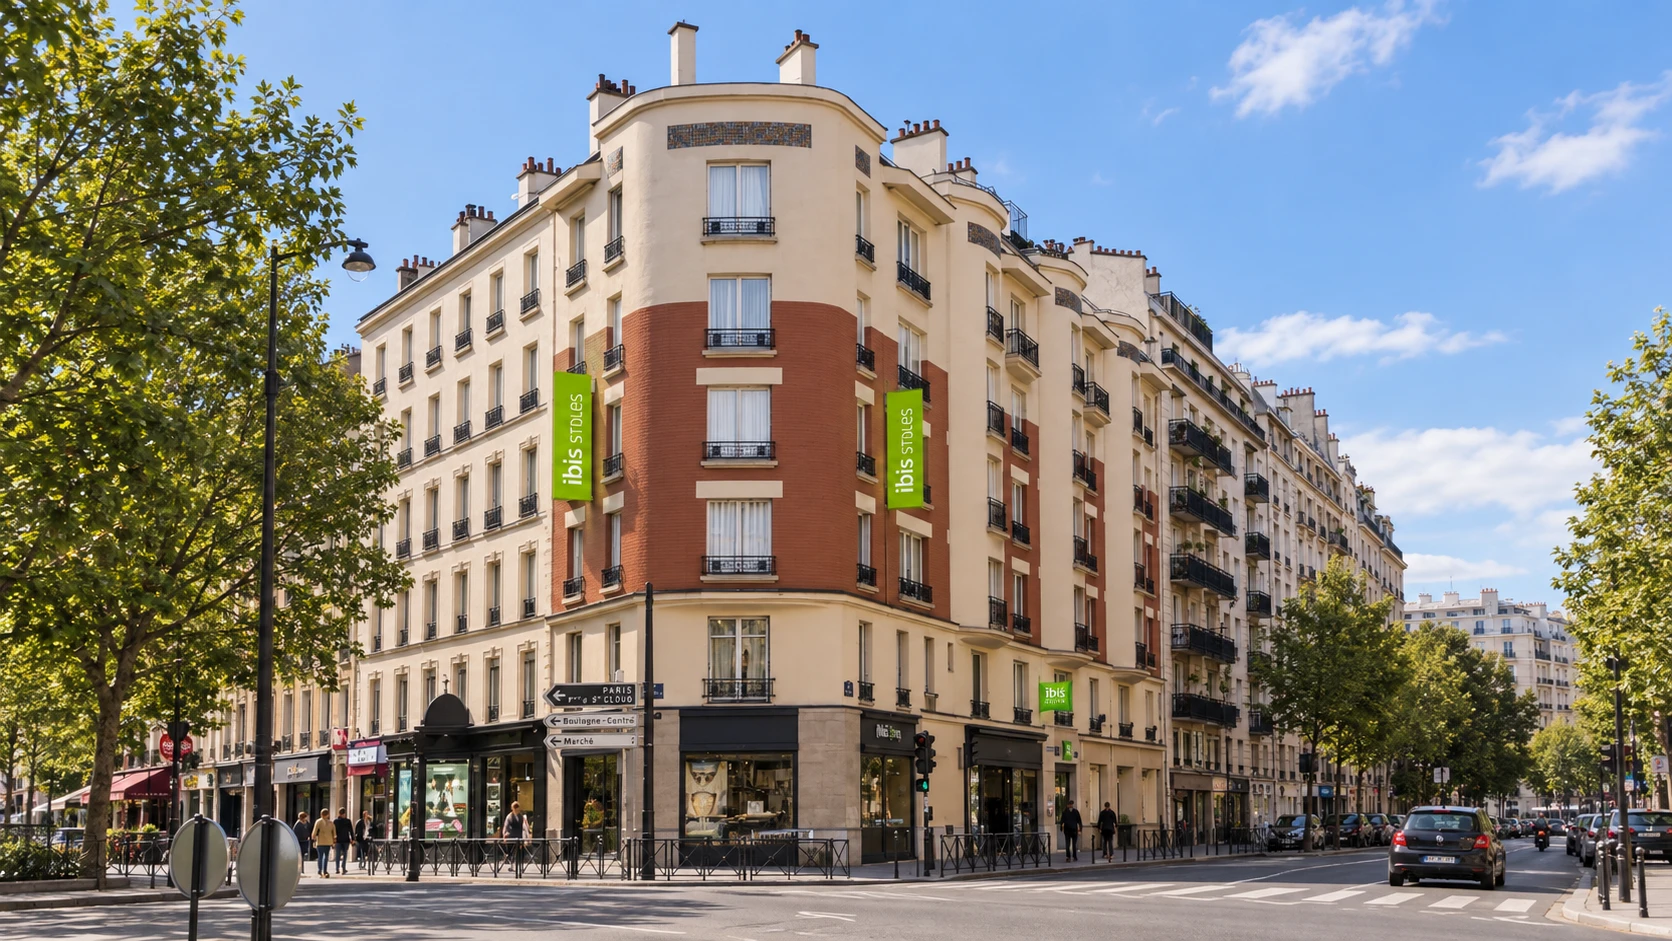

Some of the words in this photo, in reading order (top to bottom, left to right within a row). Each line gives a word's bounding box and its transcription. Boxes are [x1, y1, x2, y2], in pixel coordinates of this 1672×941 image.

[562, 448, 583, 485] ibis
[895, 458, 914, 493] ibis
[602, 686, 632, 694] PARIS
